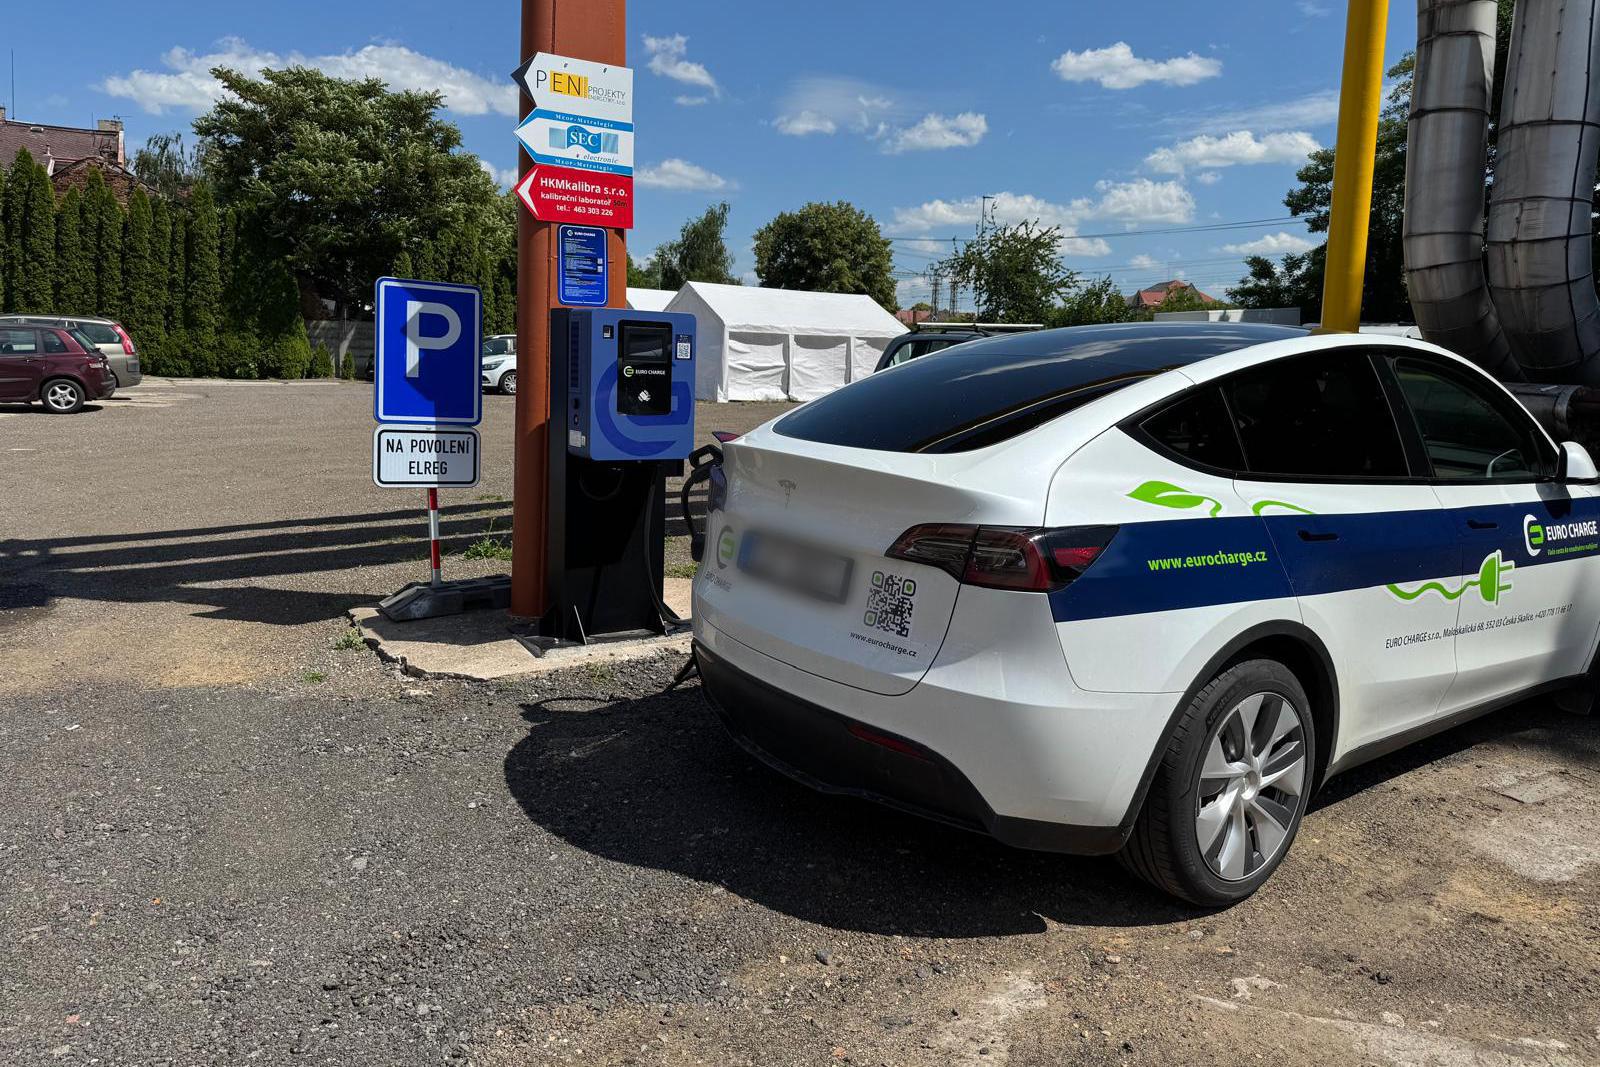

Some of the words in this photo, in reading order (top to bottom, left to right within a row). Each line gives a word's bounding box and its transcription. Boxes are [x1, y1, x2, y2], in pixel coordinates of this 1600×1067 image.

[588, 86, 626, 100] PROJEKTY
[570, 131, 599, 147] SEC
[584, 154, 618, 164] electronic
[540, 177, 601, 193] HKMkalibra
[603, 187, 628, 197] s.r.o.
[540, 192, 577, 202] kalibrační
[578, 196, 612, 206] laboratoř
[573, 206, 586, 214] 463
[587, 207, 600, 215] 303
[601, 208, 613, 217] 226
[405, 300, 462, 378] P
[386, 438, 404, 453] NA
[410, 436, 472, 454] POVOLENÍ
[408, 460, 448, 475] ELREG
[1545, 524, 1568, 541] EURO
[1568, 520, 1599, 538] CHARGE
[1147, 550, 1267, 571] www.eurocharge.cz
[1385, 636, 1403, 649] EURO
[1403, 632, 1428, 646] CHARGE
[1485, 620, 1496, 630] 552
[1495, 618, 1503, 628] 03
[1503, 615, 1517, 627] Česká
[1535, 610, 1547, 619] +420
[849, 631, 917, 657] www.eurocharge.cz
